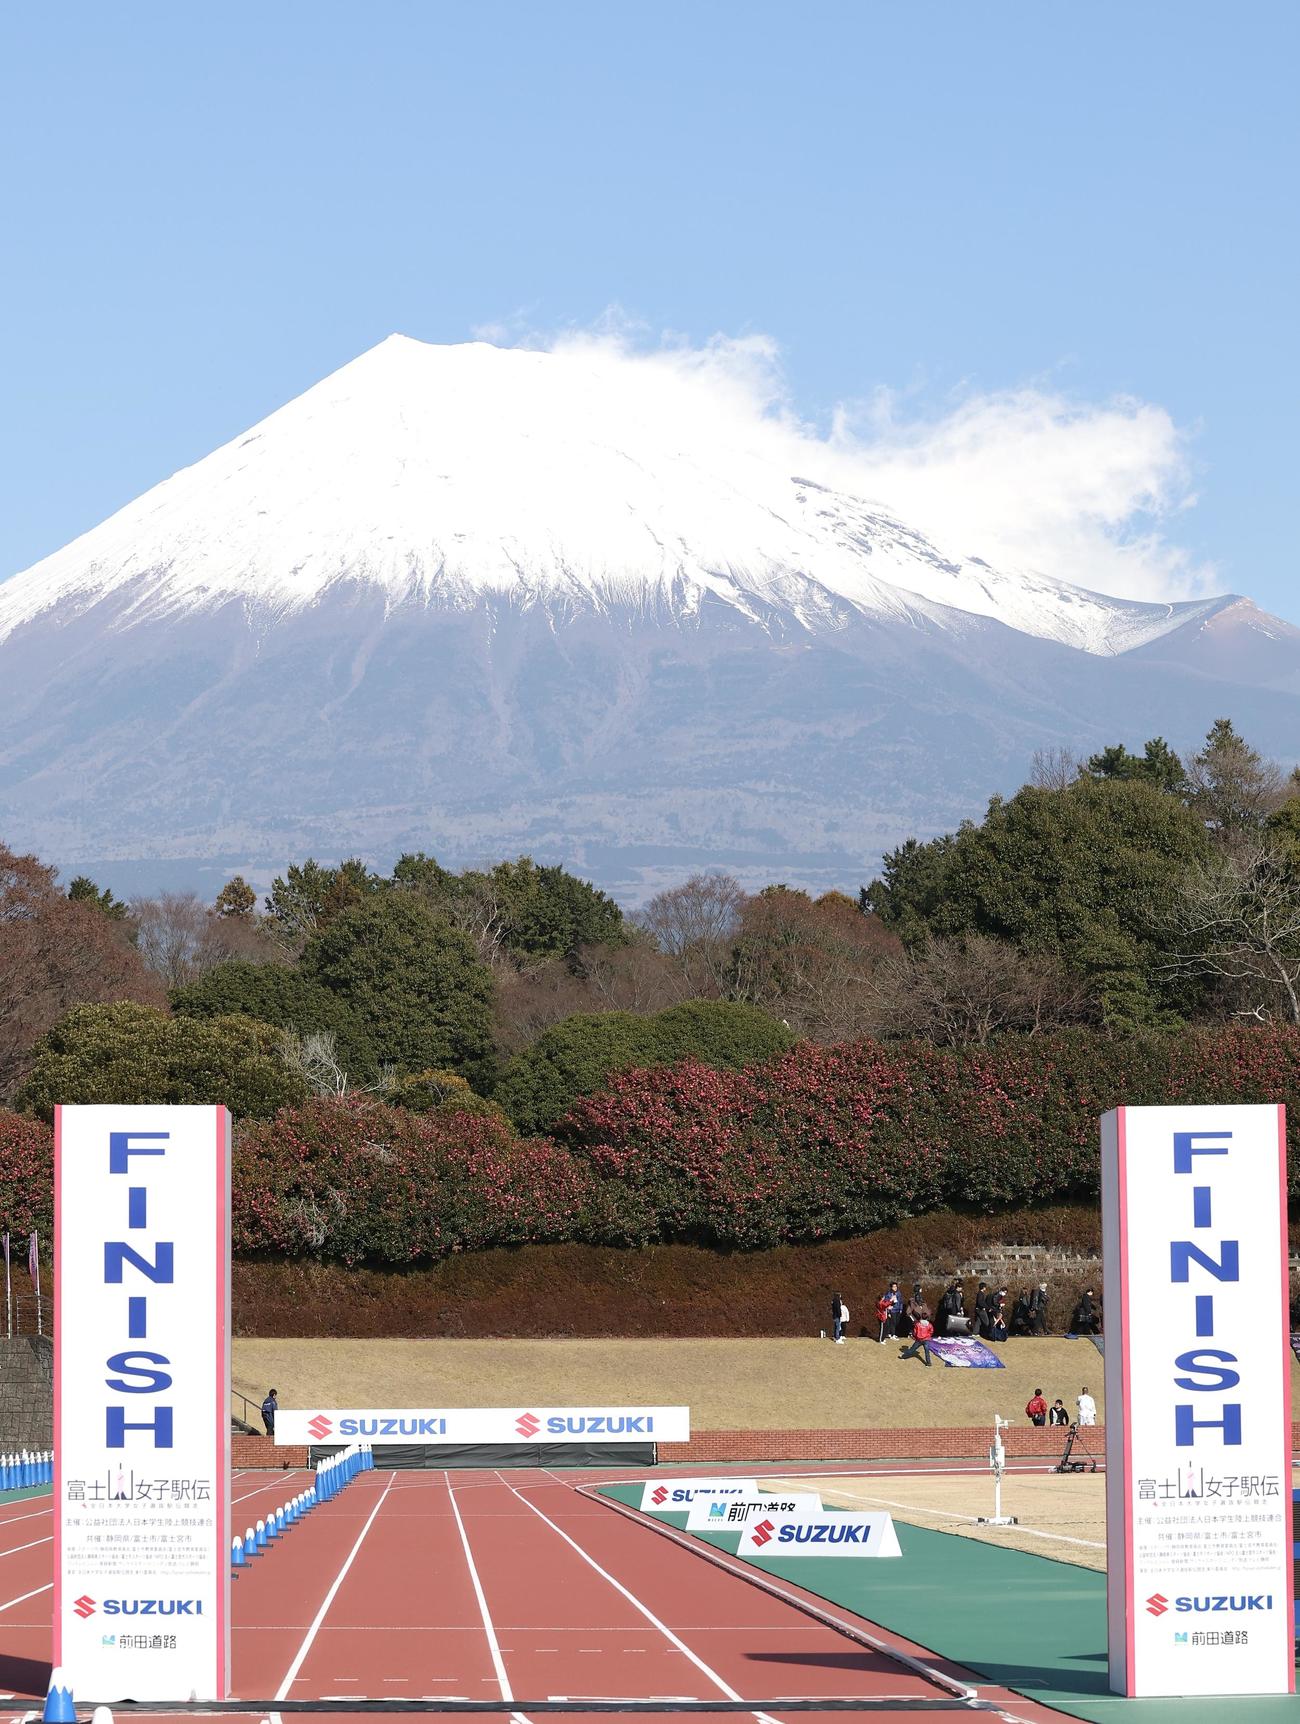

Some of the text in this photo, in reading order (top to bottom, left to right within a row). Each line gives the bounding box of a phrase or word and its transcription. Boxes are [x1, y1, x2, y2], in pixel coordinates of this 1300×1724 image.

[104, 1132, 174, 1448] FINISH
[1170, 1131, 1242, 1447] FINISH
[339, 1418, 446, 1436] SUZUKI
[547, 1416, 654, 1434] SUZUKI
[778, 1525, 871, 1543] SUZUKI
[103, 1600, 203, 1615] SUZUKI
[1175, 1595, 1273, 1612] SUZUKI
[119, 1634, 177, 1649] 前田道路
[1191, 1630, 1249, 1646] 前田道路
